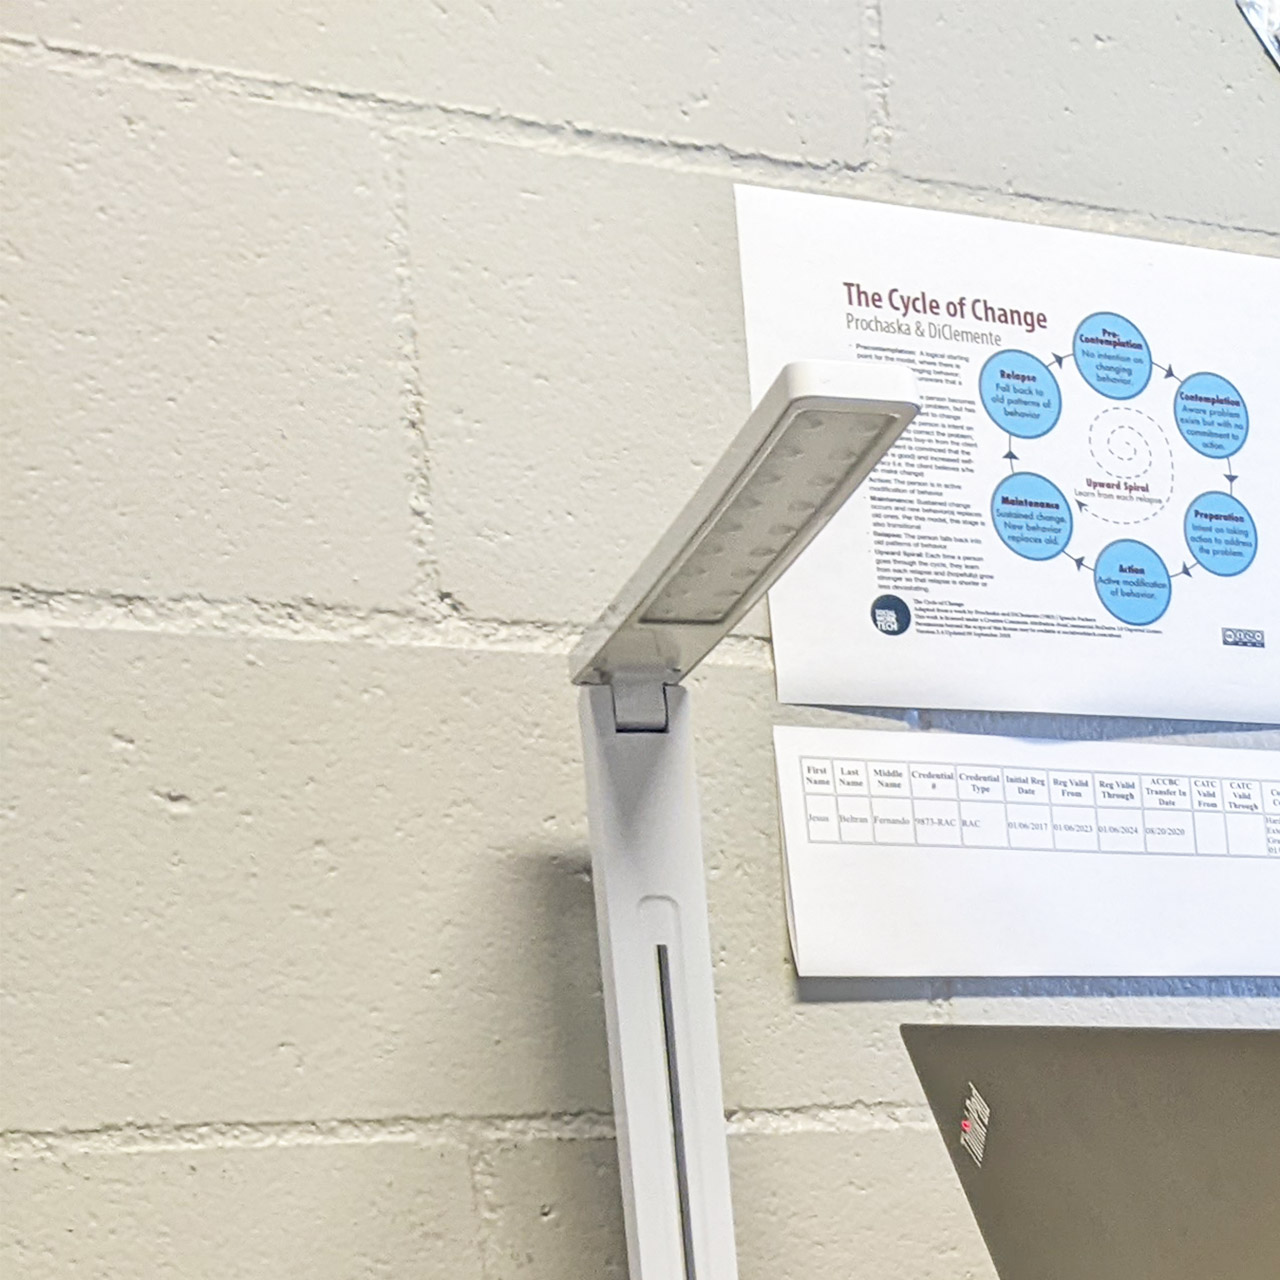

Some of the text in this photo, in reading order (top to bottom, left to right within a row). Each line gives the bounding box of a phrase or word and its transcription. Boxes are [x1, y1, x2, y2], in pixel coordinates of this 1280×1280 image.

[843, 281, 1048, 333] The Cycle of Change
[846, 313, 1001, 346] Prochaska & DiClemente
[1079, 334, 1143, 350] Contemplation
[999, 369, 1037, 383] Relapse
[996, 383, 1010, 392] Fall
[1013, 385, 1033, 395] back
[991, 395, 1005, 403] old
[1180, 391, 1240, 407] Contemplation
[1086, 478, 1149, 493] Upward Spiral
[1074, 488, 1095, 497] Learn
[1097, 489, 1114, 499] from
[1001, 495, 1060, 510] Maintenance
[1194, 509, 1245, 523] Preparation
[1119, 564, 1145, 575] Action
[807, 766, 827, 775] First
[841, 767, 859, 776] Last
[874, 769, 903, 778] Middle
[911, 770, 954, 780] Credential
[806, 777, 830, 786] Name
[959, 773, 1000, 782] Credential
[1006, 775, 1045, 786] Initial Reg
[839, 778, 864, 787] Name
[878, 780, 902, 789] Name
[1053, 778, 1088, 788] Reg Valid
[1099, 781, 1135, 790] Reg Valid
[1194, 780, 1217, 788] CATC
[1230, 782, 1253, 790] CATC
[972, 784, 991, 793] Type
[1018, 787, 1035, 796] Date
[1145, 787, 1177, 796] Transfer
[1062, 789, 1082, 798] From
[1101, 791, 1135, 801] Through
[1197, 790, 1216, 798] Valid
[1233, 792, 1251, 800] Valid
[1159, 798, 1176, 806] Date
[1198, 800, 1217, 808] From
[1228, 801, 1258, 811] Through
[874, 816, 910, 825] Fernando
[961, 820, 981, 828] RAC
